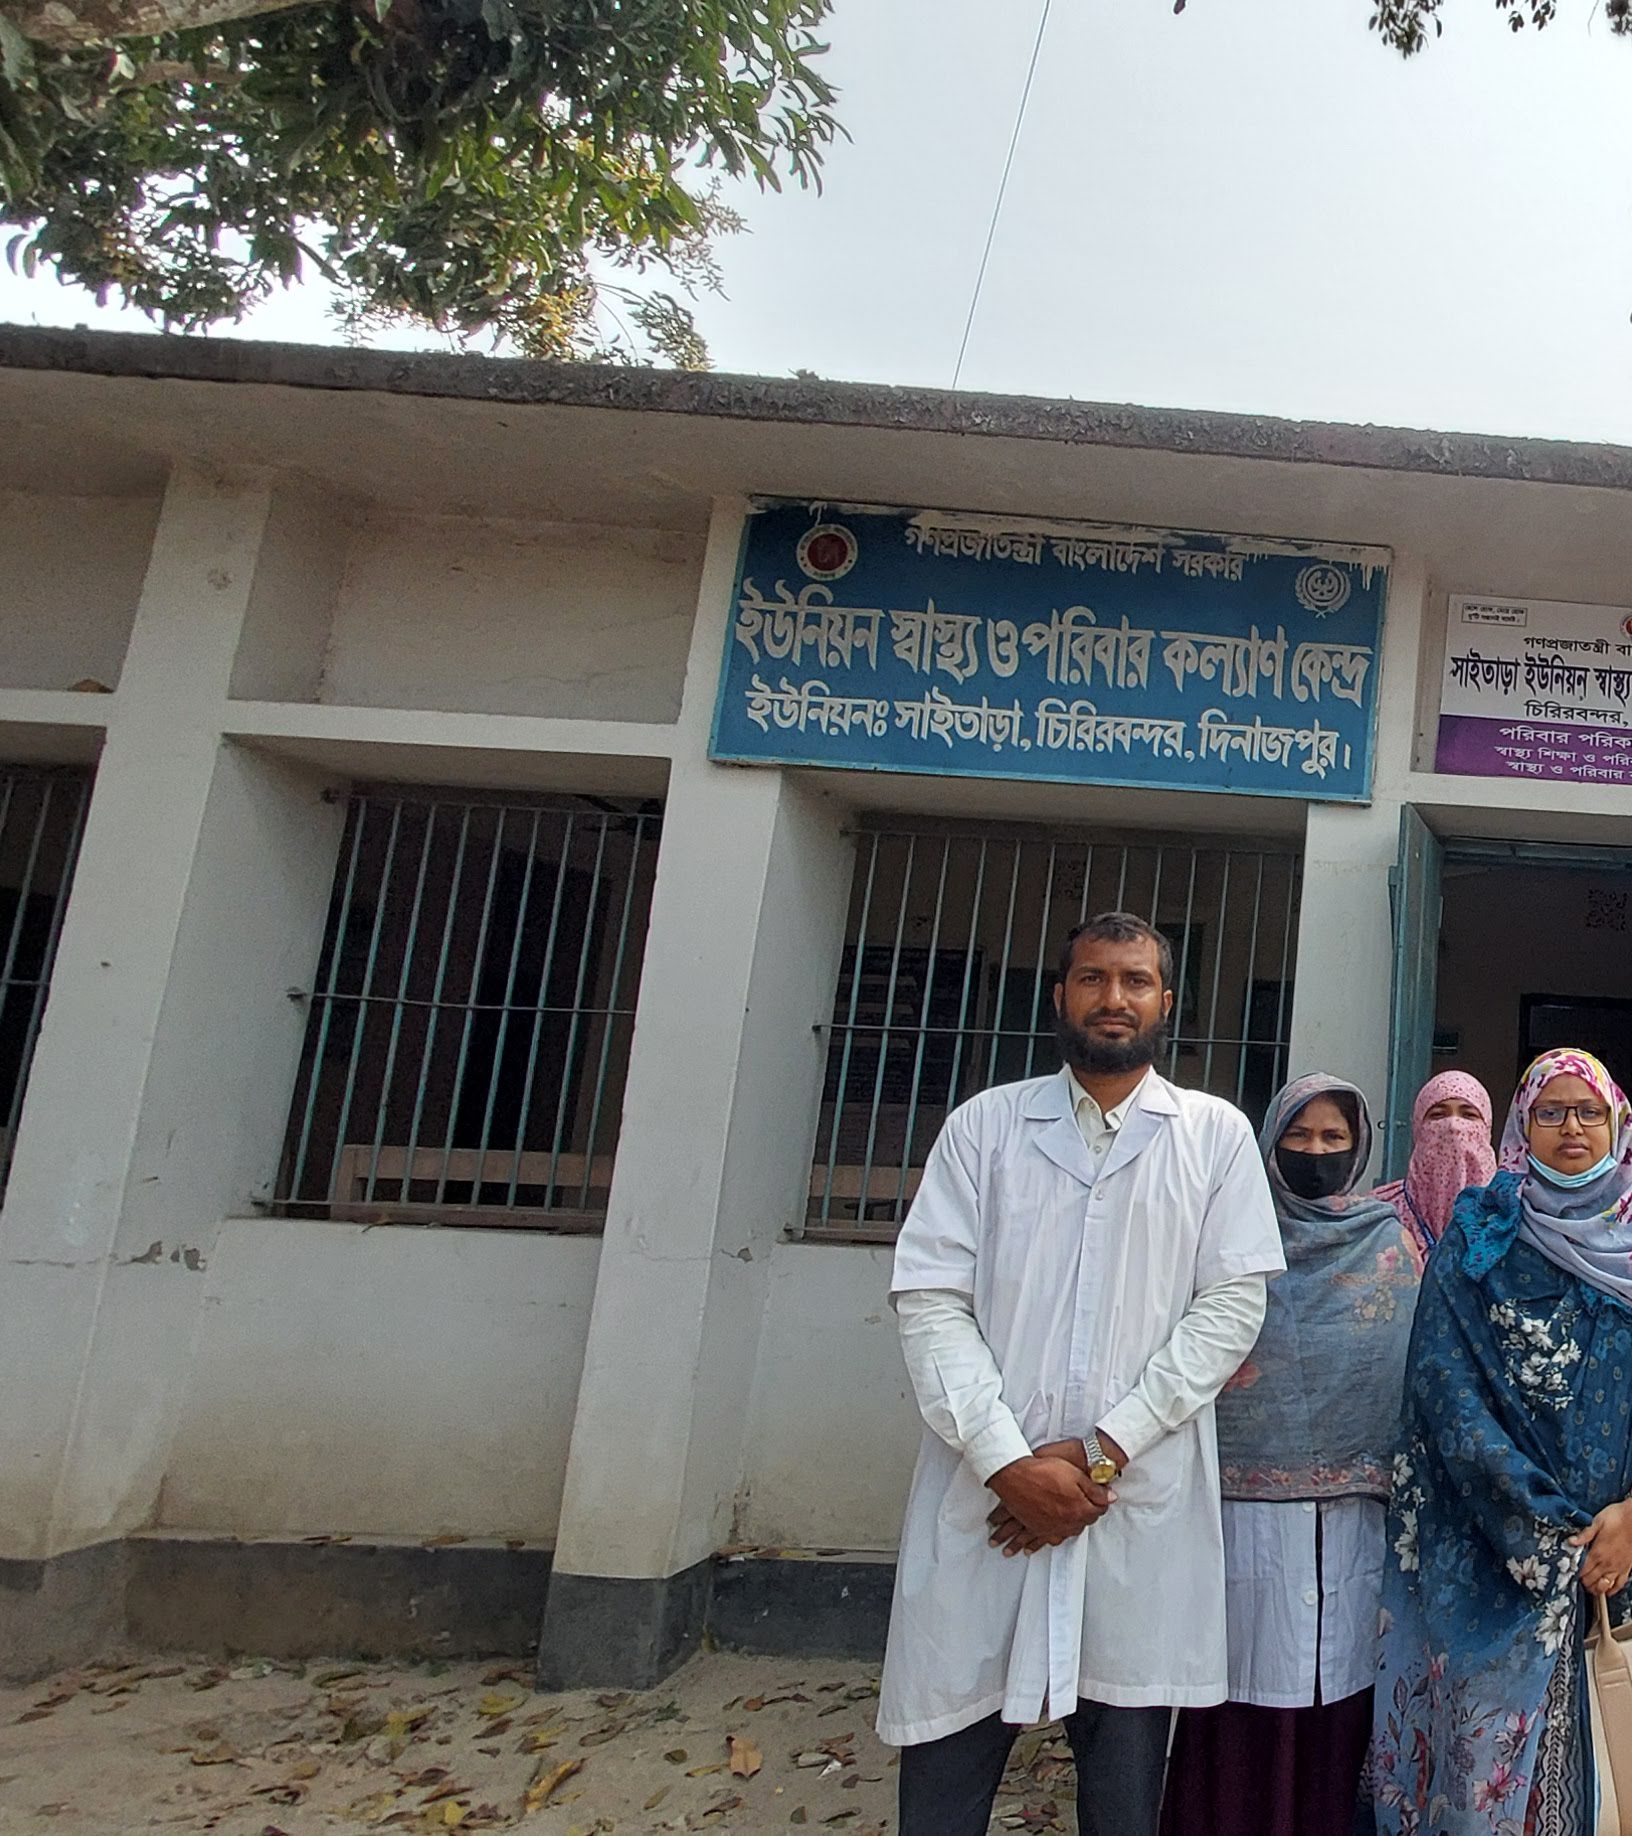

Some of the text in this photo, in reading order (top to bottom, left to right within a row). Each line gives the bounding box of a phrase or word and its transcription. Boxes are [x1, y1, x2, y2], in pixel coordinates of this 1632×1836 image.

[1051, 538, 1166, 575] বাংলাদেশ
[1172, 548, 1246, 581] সরকার
[735, 577, 1373, 708] ইউনিয়ন স্বাস্থ্য ও পরিবার কল্যাণ কেন্দ্র
[1450, 648, 1521, 695] সাইতাড়া
[1523, 652, 1591, 697] ইউনিয়ন
[894, 686, 1031, 752] সাইতাড়া,
[1034, 697, 1195, 763] চিরিরবন্দর,
[1499, 725, 1572, 744] পরিবার
[1550, 765, 1563, 774] ও
[1569, 764, 1625, 780] পরিবার
[1582, 753, 1596, 762] ও
